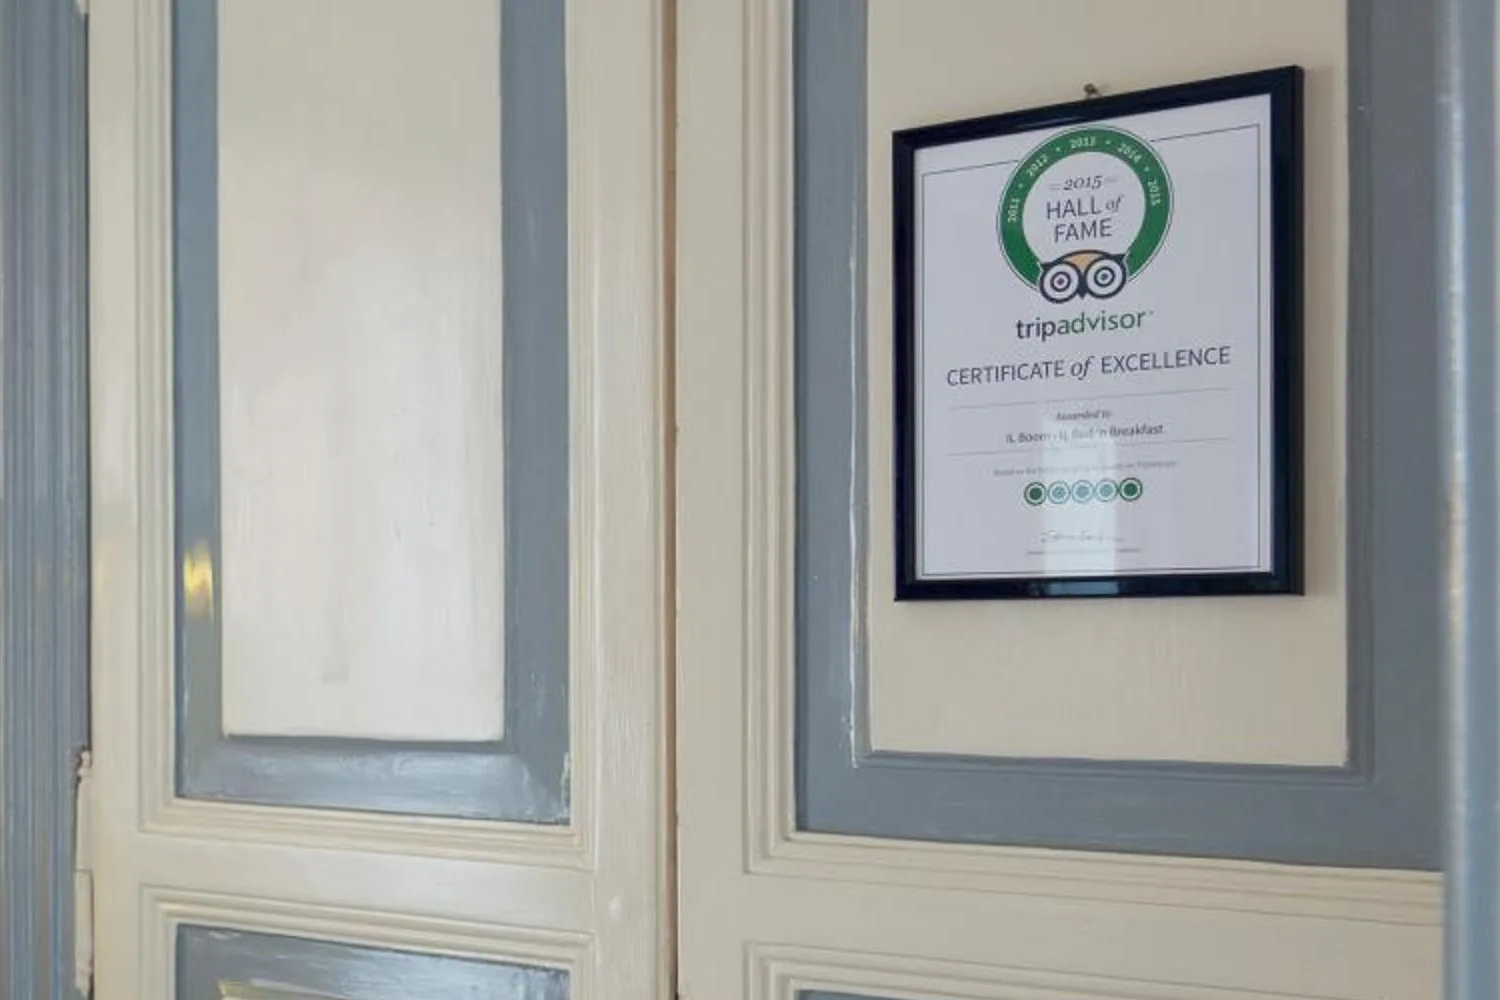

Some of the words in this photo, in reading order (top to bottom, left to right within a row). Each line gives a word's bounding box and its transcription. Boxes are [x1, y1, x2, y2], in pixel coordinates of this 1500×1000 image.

[1063, 176, 1103, 191] 2015
[1046, 198, 1102, 220] HALL
[1105, 194, 1124, 213] of
[1054, 218, 1113, 243] FAME
[1016, 310, 1147, 342] tripadvisor
[947, 359, 1065, 386] CERTIFICATE
[1070, 355, 1095, 380] of
[1100, 345, 1231, 374] EXCELLENCE
